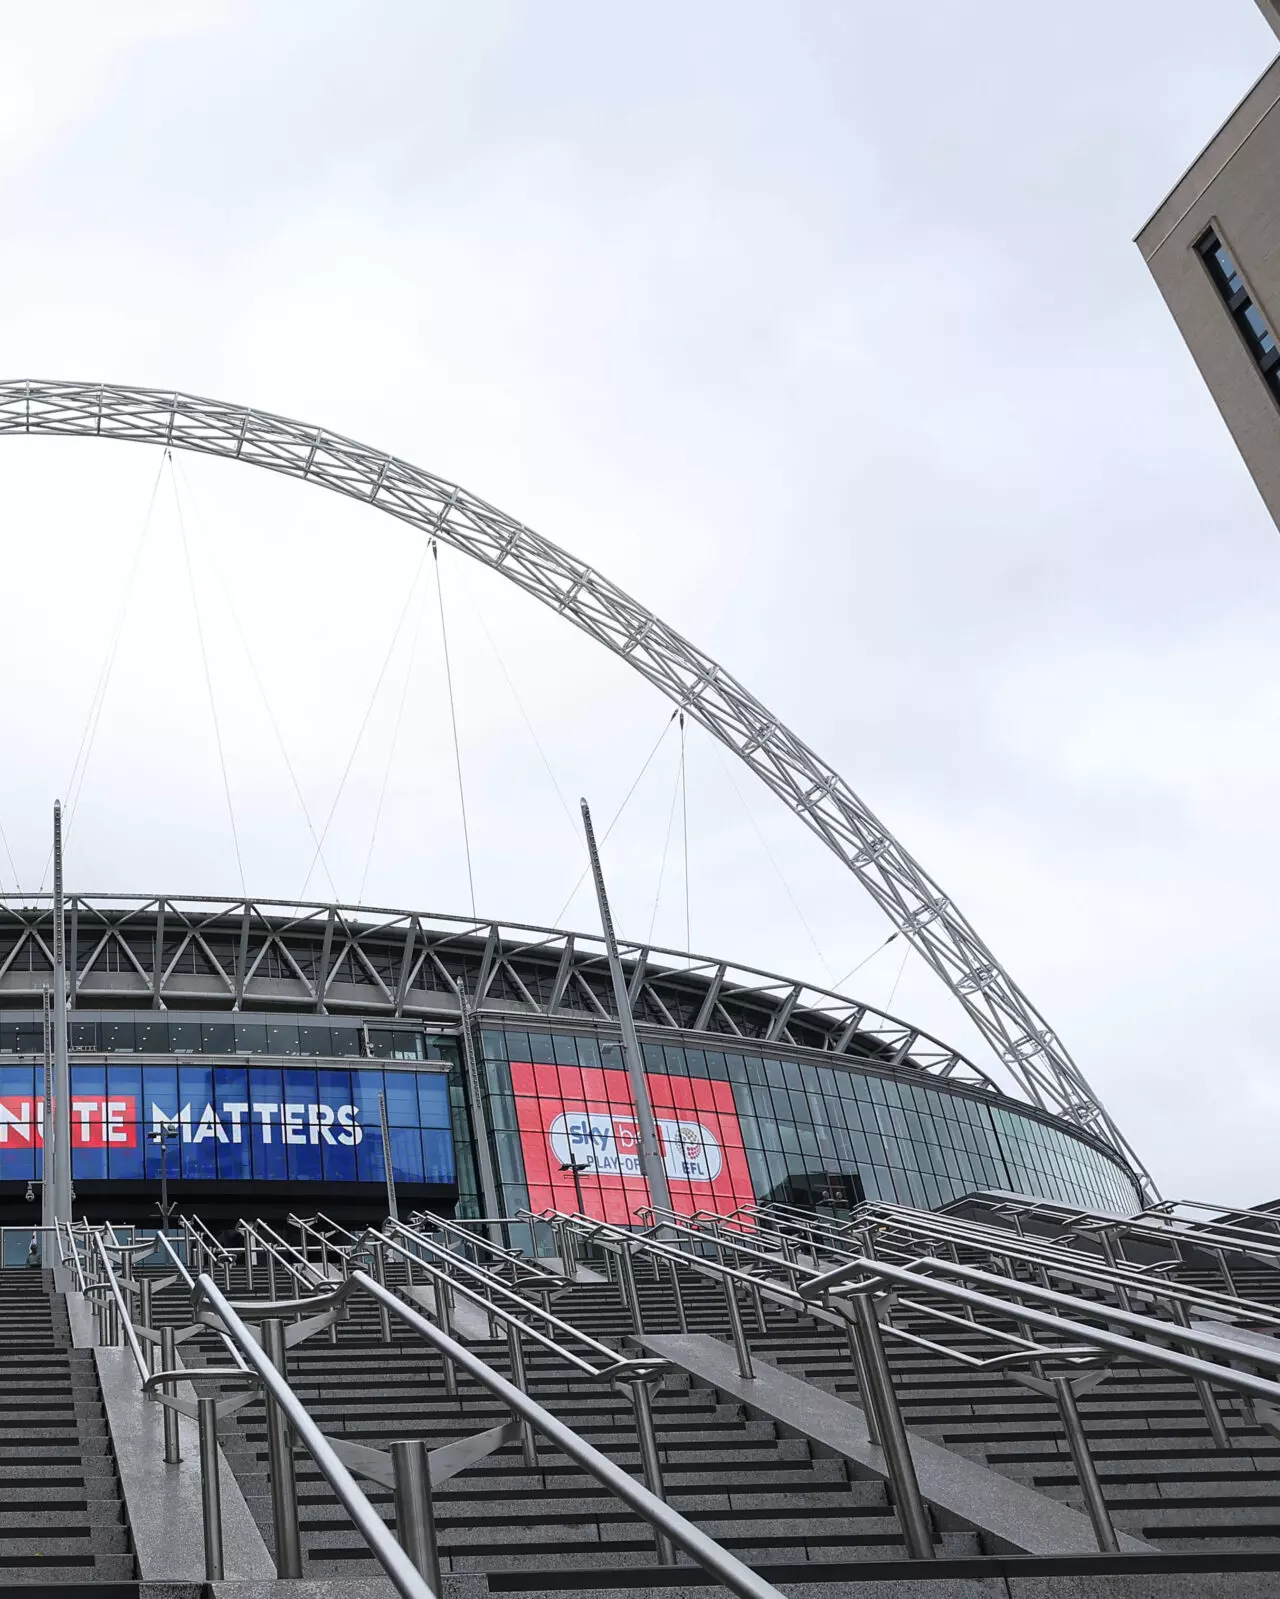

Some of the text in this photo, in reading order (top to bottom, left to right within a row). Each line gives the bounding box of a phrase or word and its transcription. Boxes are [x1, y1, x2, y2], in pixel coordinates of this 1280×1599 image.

[152, 1101, 363, 1146] MATTERS
[570, 1120, 609, 1151] sky
[586, 1155, 641, 1171] PLAY-OF
[681, 1161, 705, 1176] EFL
